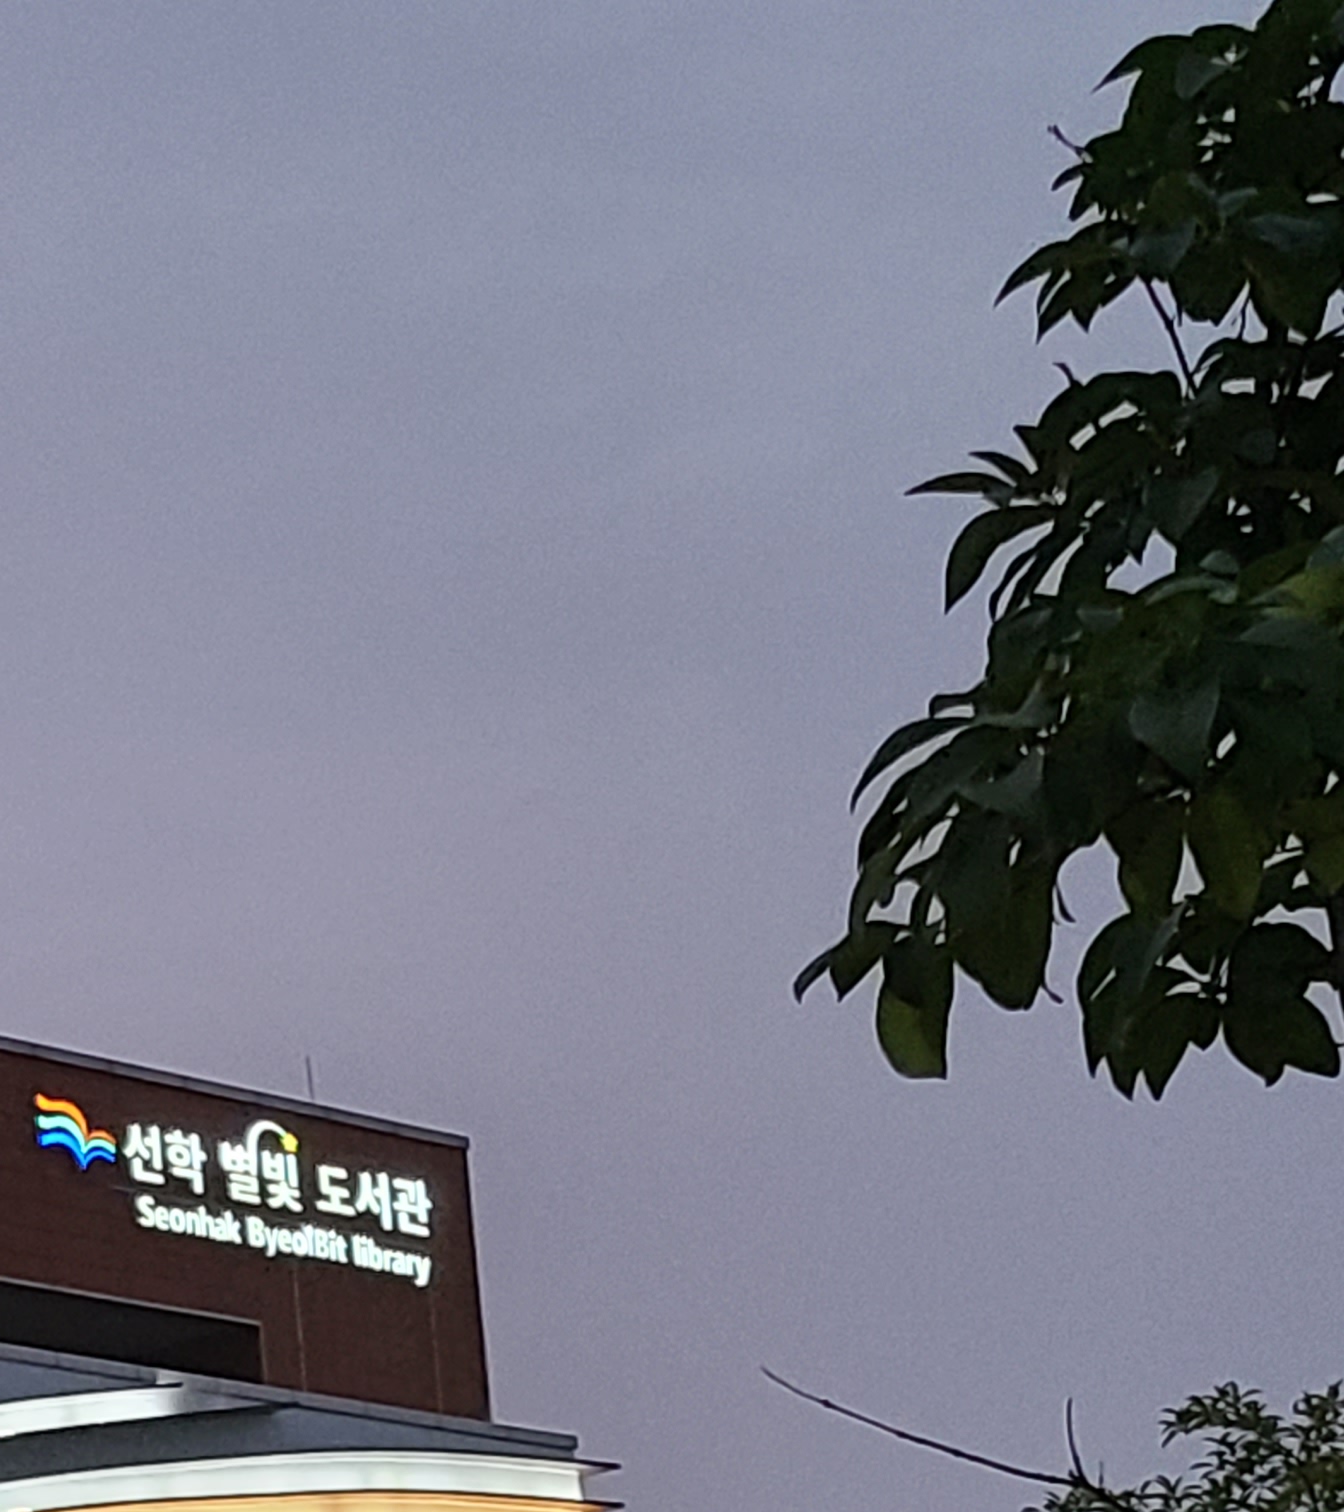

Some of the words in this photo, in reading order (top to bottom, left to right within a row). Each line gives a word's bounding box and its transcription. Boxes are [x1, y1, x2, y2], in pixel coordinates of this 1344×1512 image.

[123, 1122, 208, 1195] 선학
[217, 1119, 304, 1213] 별빛
[314, 1163, 434, 1238] 도서관
[134, 1194, 242, 1245] Seonhak
[245, 1215, 348, 1265] ByeolBit
[351, 1233, 432, 1288] library
